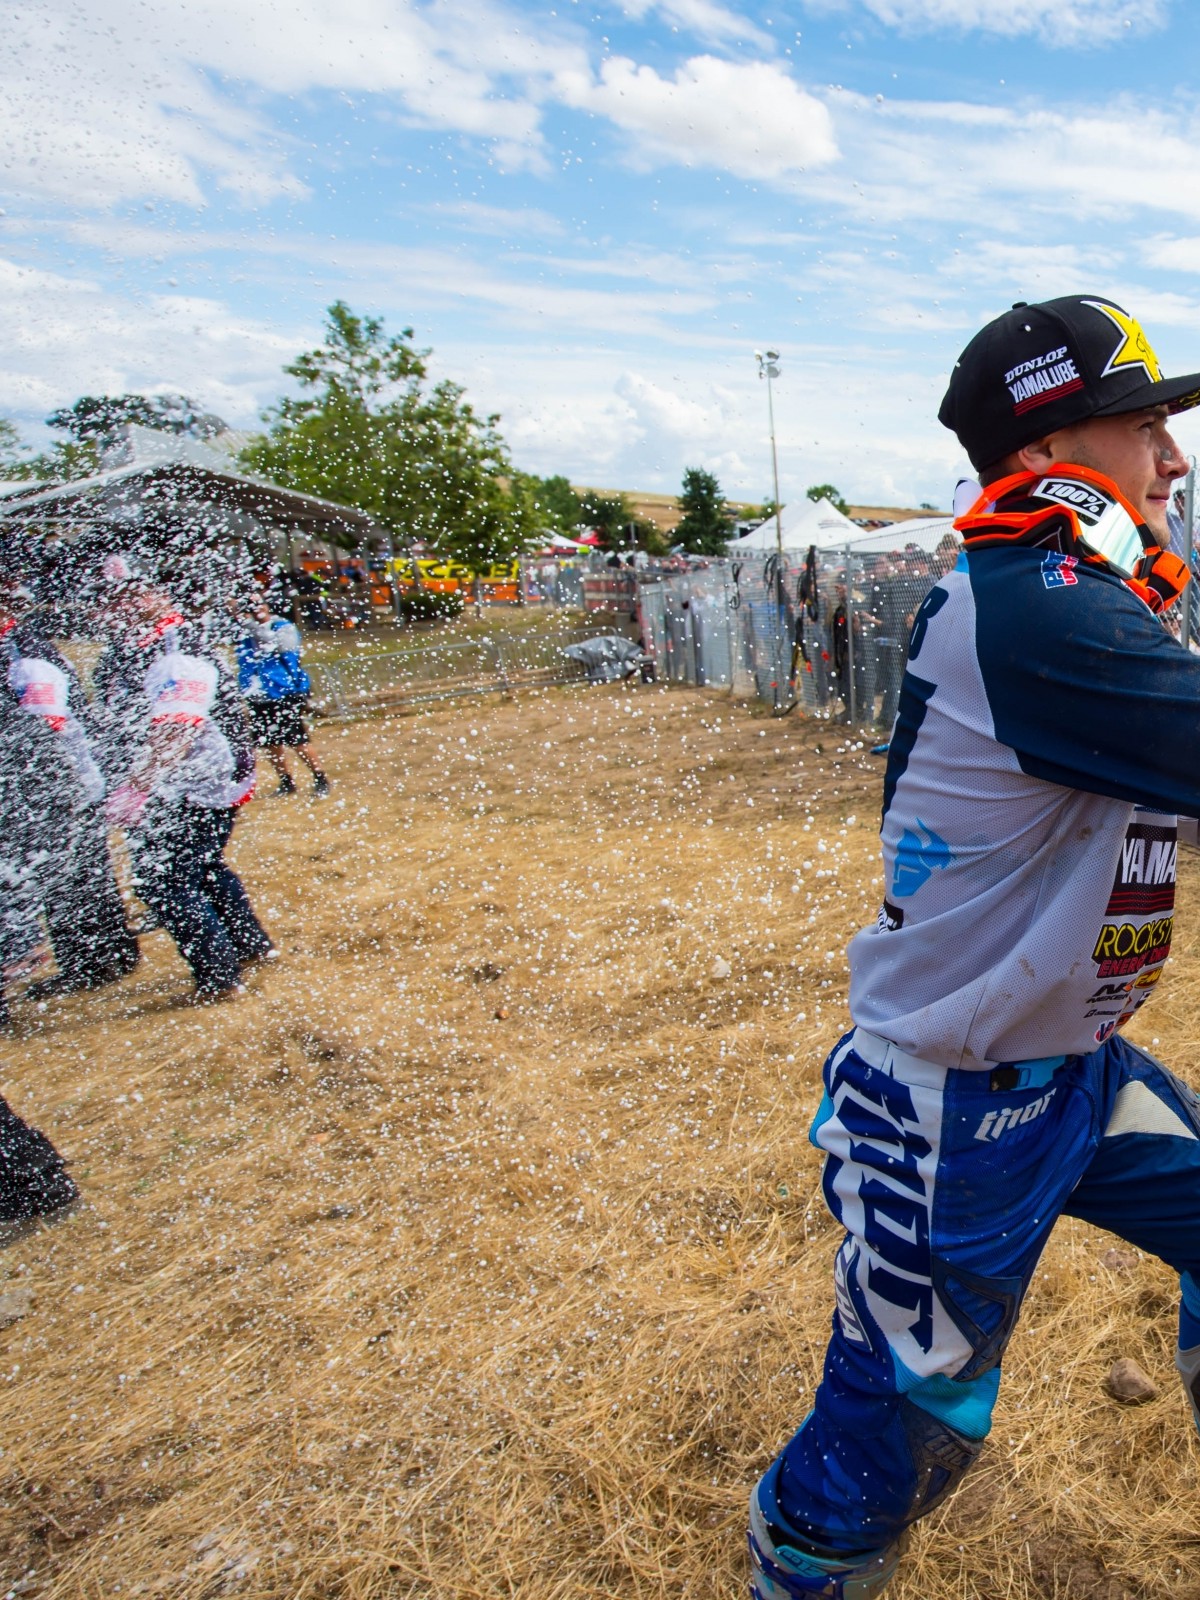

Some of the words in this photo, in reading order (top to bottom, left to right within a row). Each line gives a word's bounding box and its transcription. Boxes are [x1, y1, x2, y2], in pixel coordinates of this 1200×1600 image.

[1004, 345, 1068, 384] DUNLOP
[1008, 358, 1080, 404] YAMALUBE
[1045, 482, 1105, 514] 100%
[973, 1088, 1058, 1143] thor
